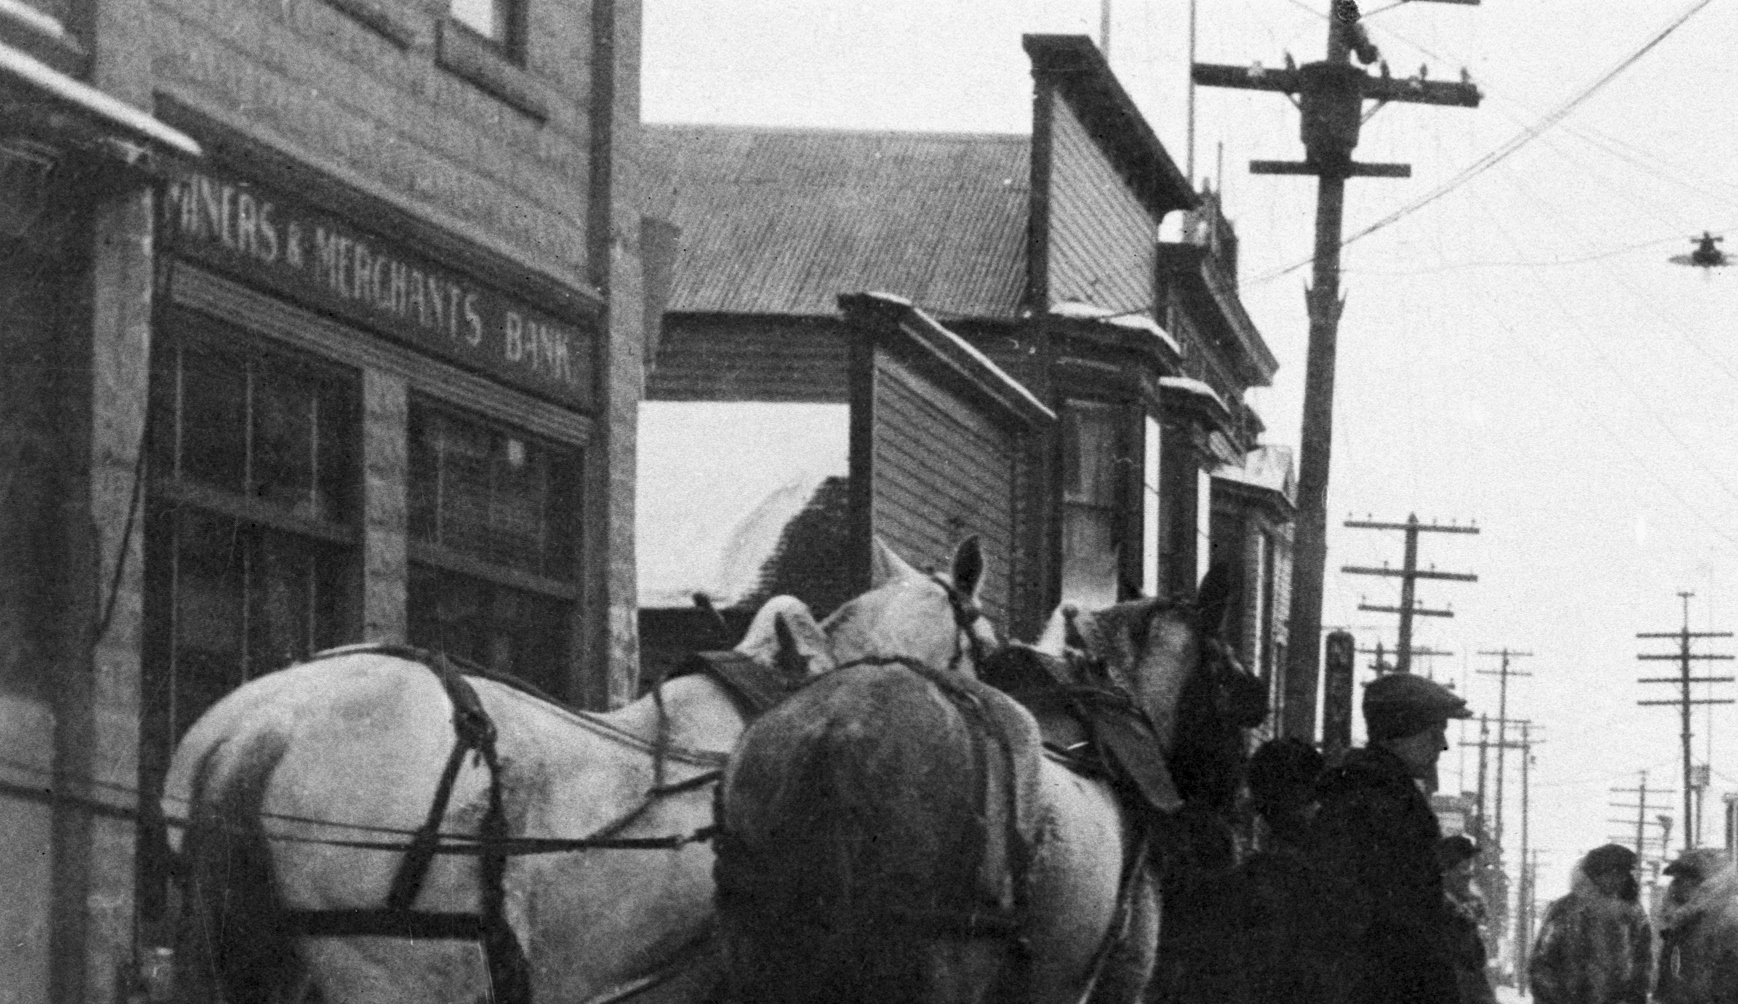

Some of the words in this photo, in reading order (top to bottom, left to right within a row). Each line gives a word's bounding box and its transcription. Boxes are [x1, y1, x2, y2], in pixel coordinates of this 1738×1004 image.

[286, 221, 304, 269] &
[315, 228, 483, 347] MERCHANTS
[504, 310, 573, 384] BANK
